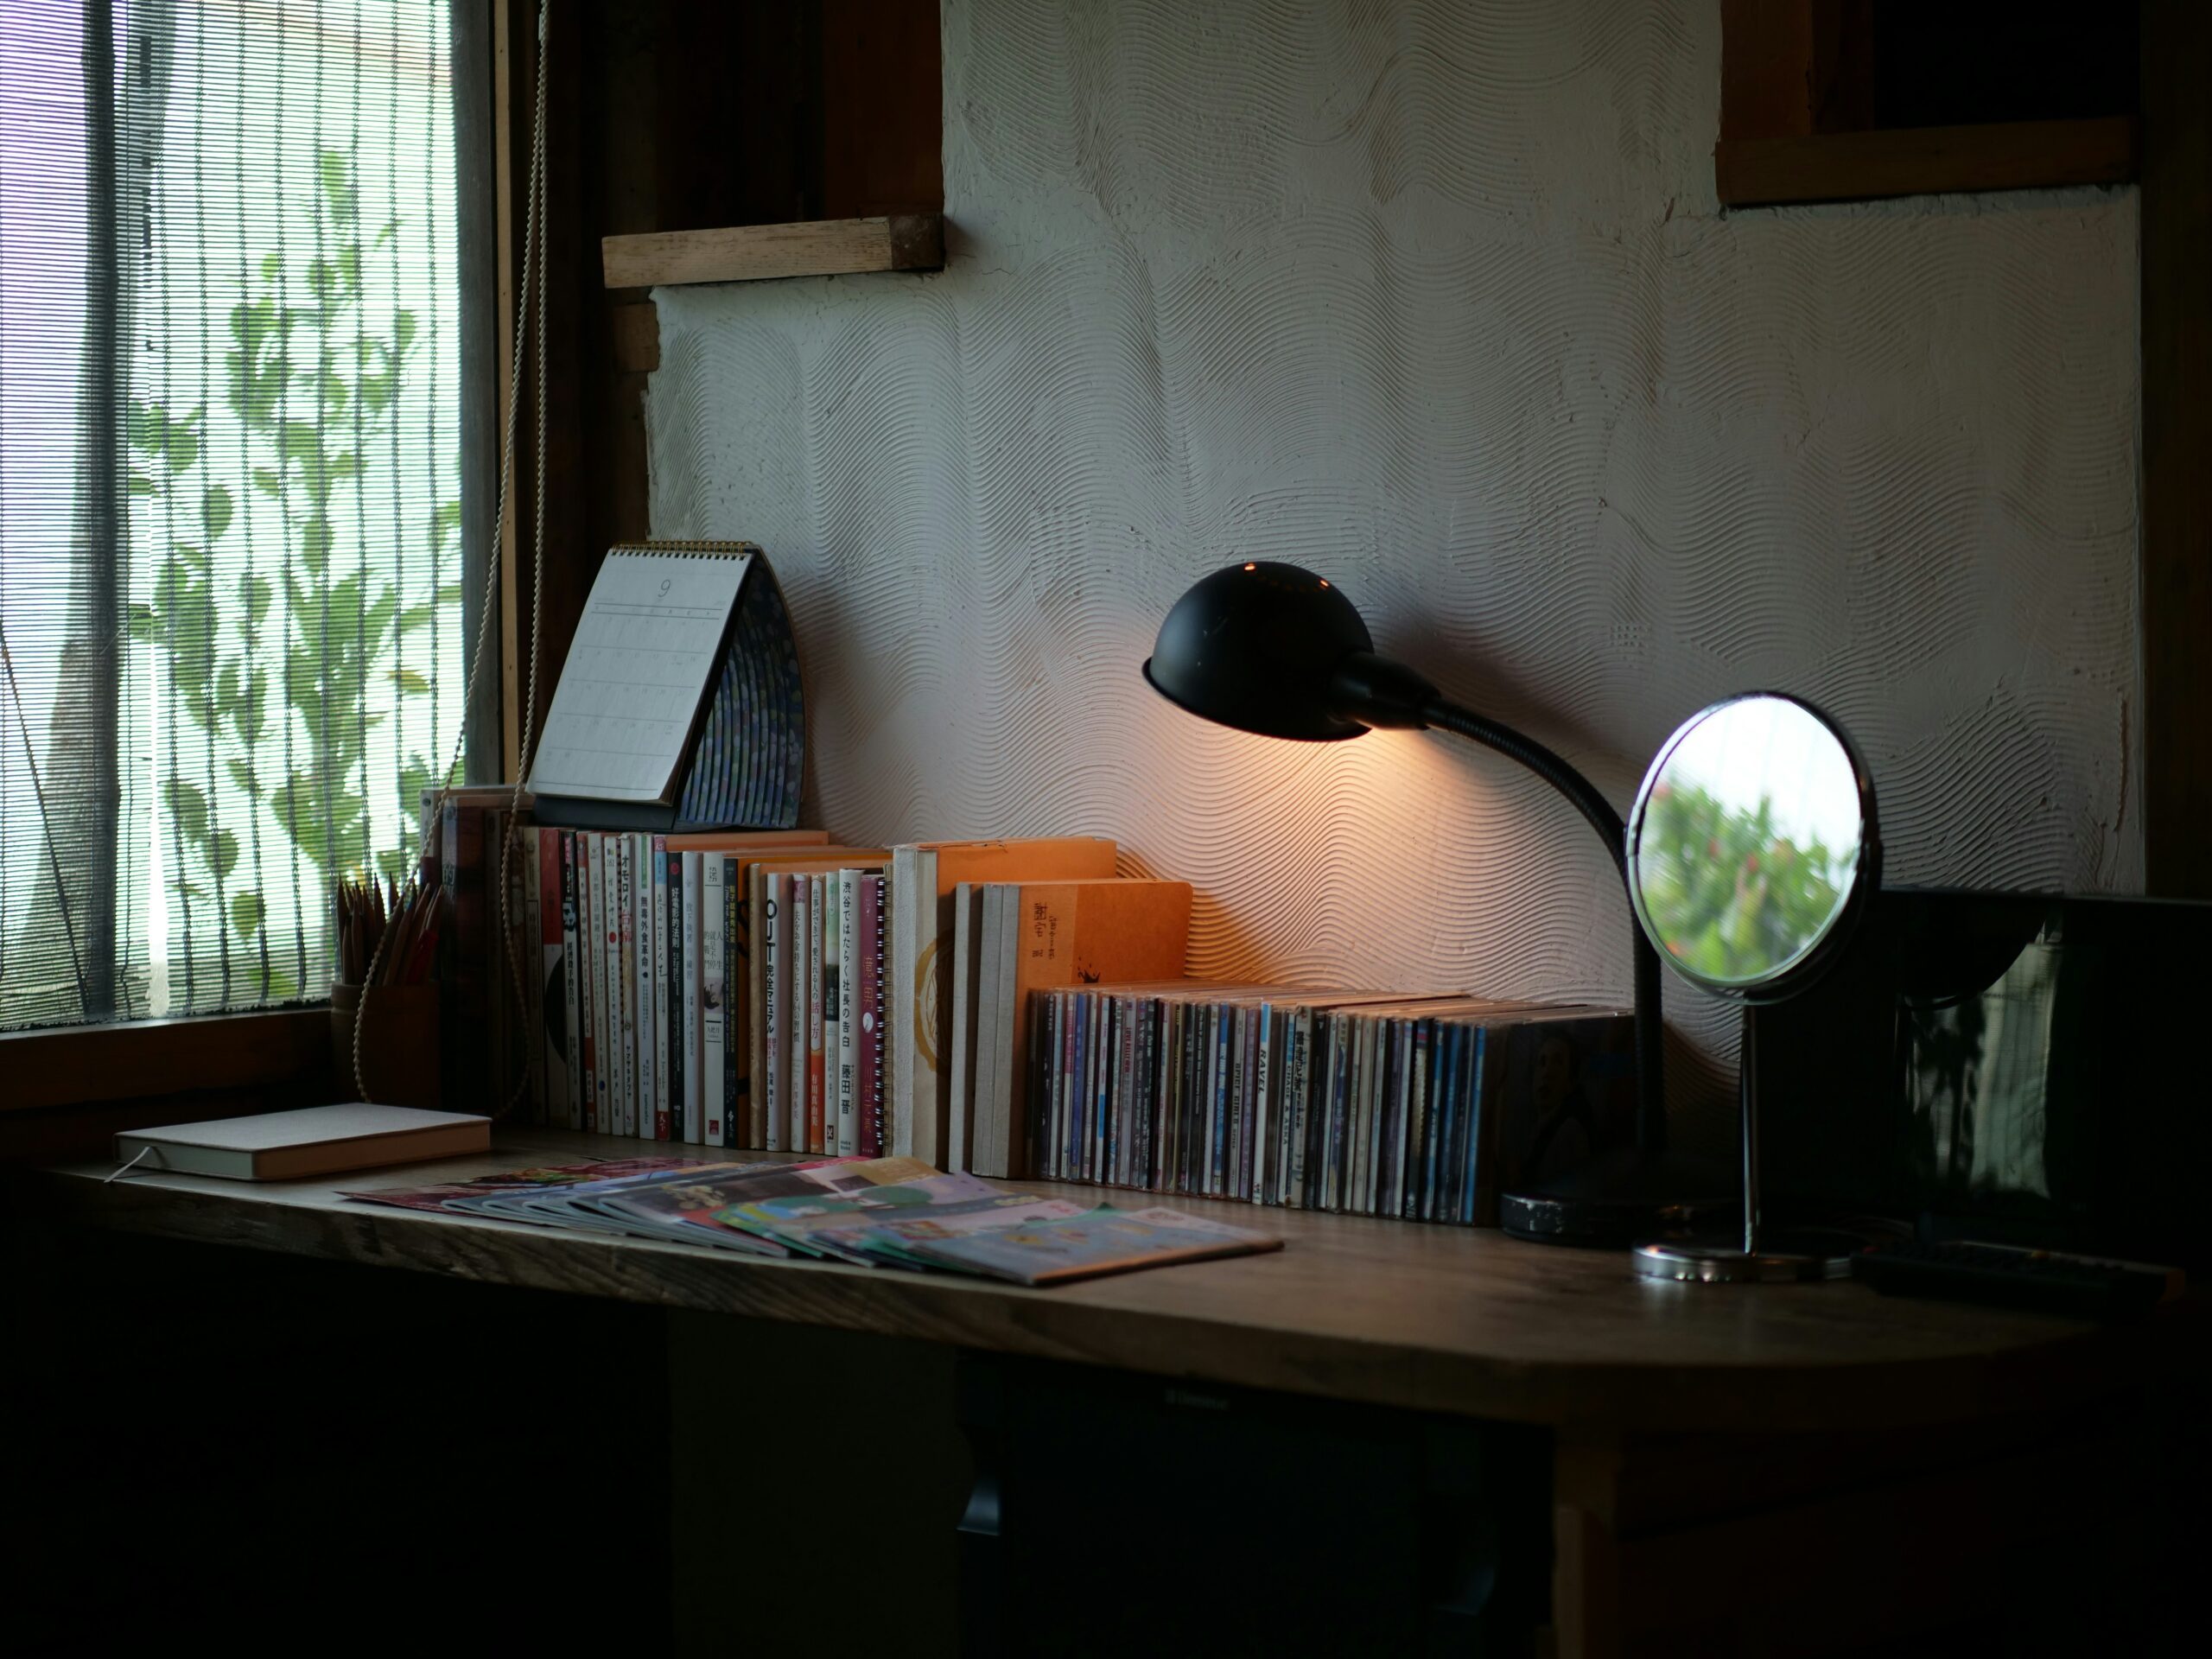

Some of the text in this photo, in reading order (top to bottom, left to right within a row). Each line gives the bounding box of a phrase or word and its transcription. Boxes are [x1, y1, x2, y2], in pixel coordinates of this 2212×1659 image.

[658, 578, 671, 598] 9
[640, 896, 649, 967] 無毒外食革命
[671, 887, 680, 948] 好電影的法則
[842, 881, 852, 1047] 渋谷ではたらく社長の告白
[842, 1064, 851, 1115] 藤田 晋
[1258, 1049, 1267, 1094] RAVEL
[810, 1074, 819, 1127] 有川真由美
